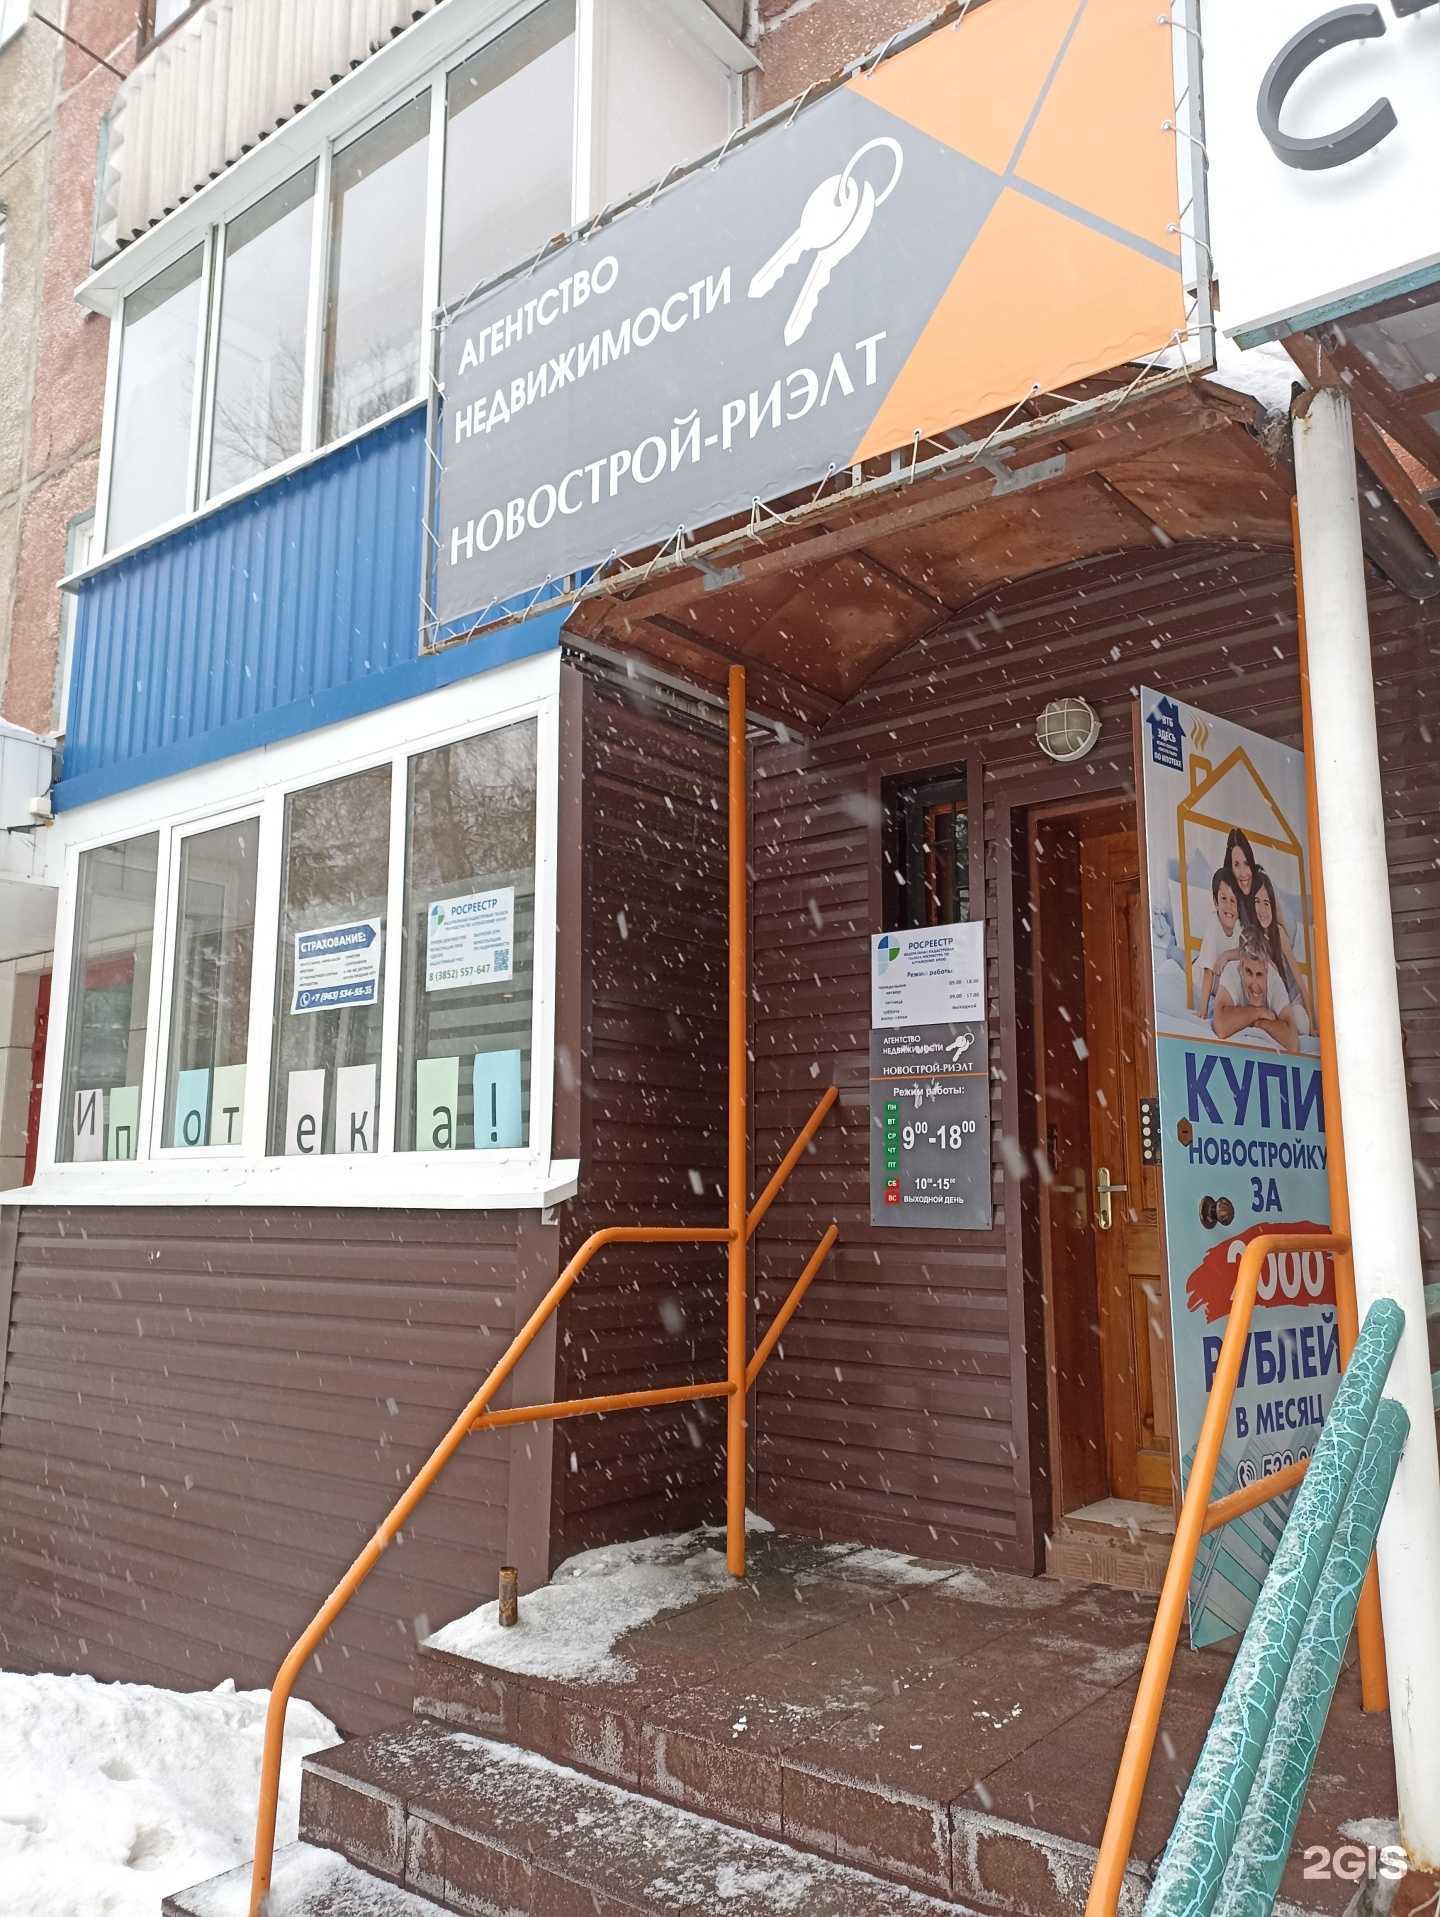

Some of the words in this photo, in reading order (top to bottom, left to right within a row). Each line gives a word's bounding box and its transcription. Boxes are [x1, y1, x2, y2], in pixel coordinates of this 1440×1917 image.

[458, 256, 619, 376] АГЕНТСТВО
[455, 266, 731, 443] НЕДВИЖИМОСТИ
[451, 332, 887, 565] НОВОСТРОЙ-РИЭЛТ
[451, 899, 498, 915] РОСРЕЕСТР
[908, 937, 954, 950] РОСРЕЕСТР
[883, 1035, 921, 1045] АГЕНТСТВО
[883, 1062, 973, 1075] НОВОСТРОЙ-РИЭЛТ
[893, 1087, 923, 1097] Режим
[1185, 1052, 1326, 1133] КУПИ
[887, 1132, 897, 1140] СР
[903, 1195, 943, 1204] ВЫХОДНОЙ
[944, 1196, 964, 1204] ДЕНЬ
[1250, 1176, 1283, 1213] ЗА
[1235, 1406, 1249, 1438] В
[1256, 1393, 1325, 1435] МЕСЯЦ
